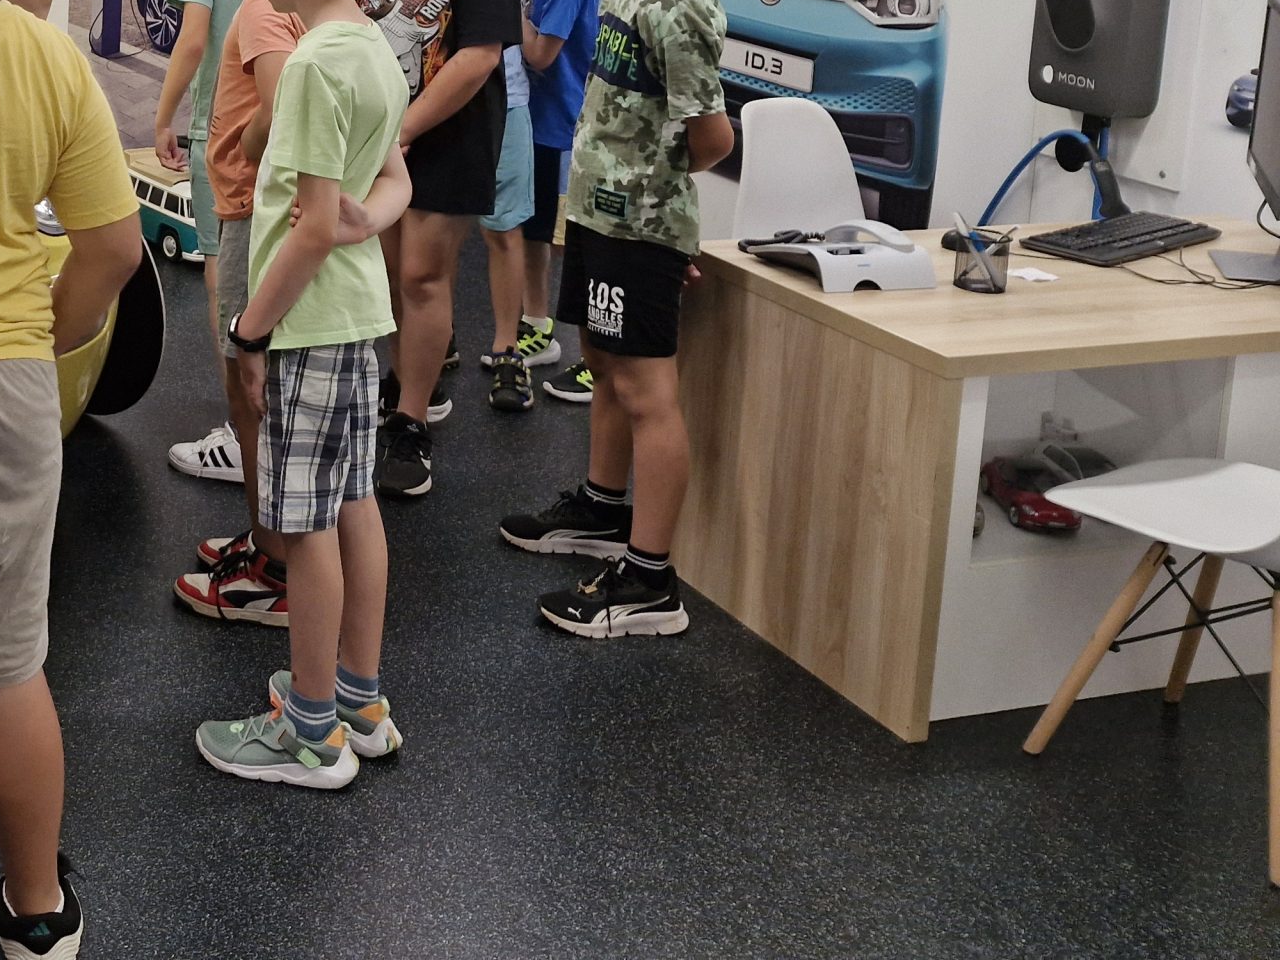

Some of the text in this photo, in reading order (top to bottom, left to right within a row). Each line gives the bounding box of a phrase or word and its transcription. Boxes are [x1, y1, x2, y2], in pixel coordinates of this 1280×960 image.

[744, 50, 783, 76] ID.3
[1058, 71, 1095, 90] MOON
[588, 278, 625, 314] LOS
